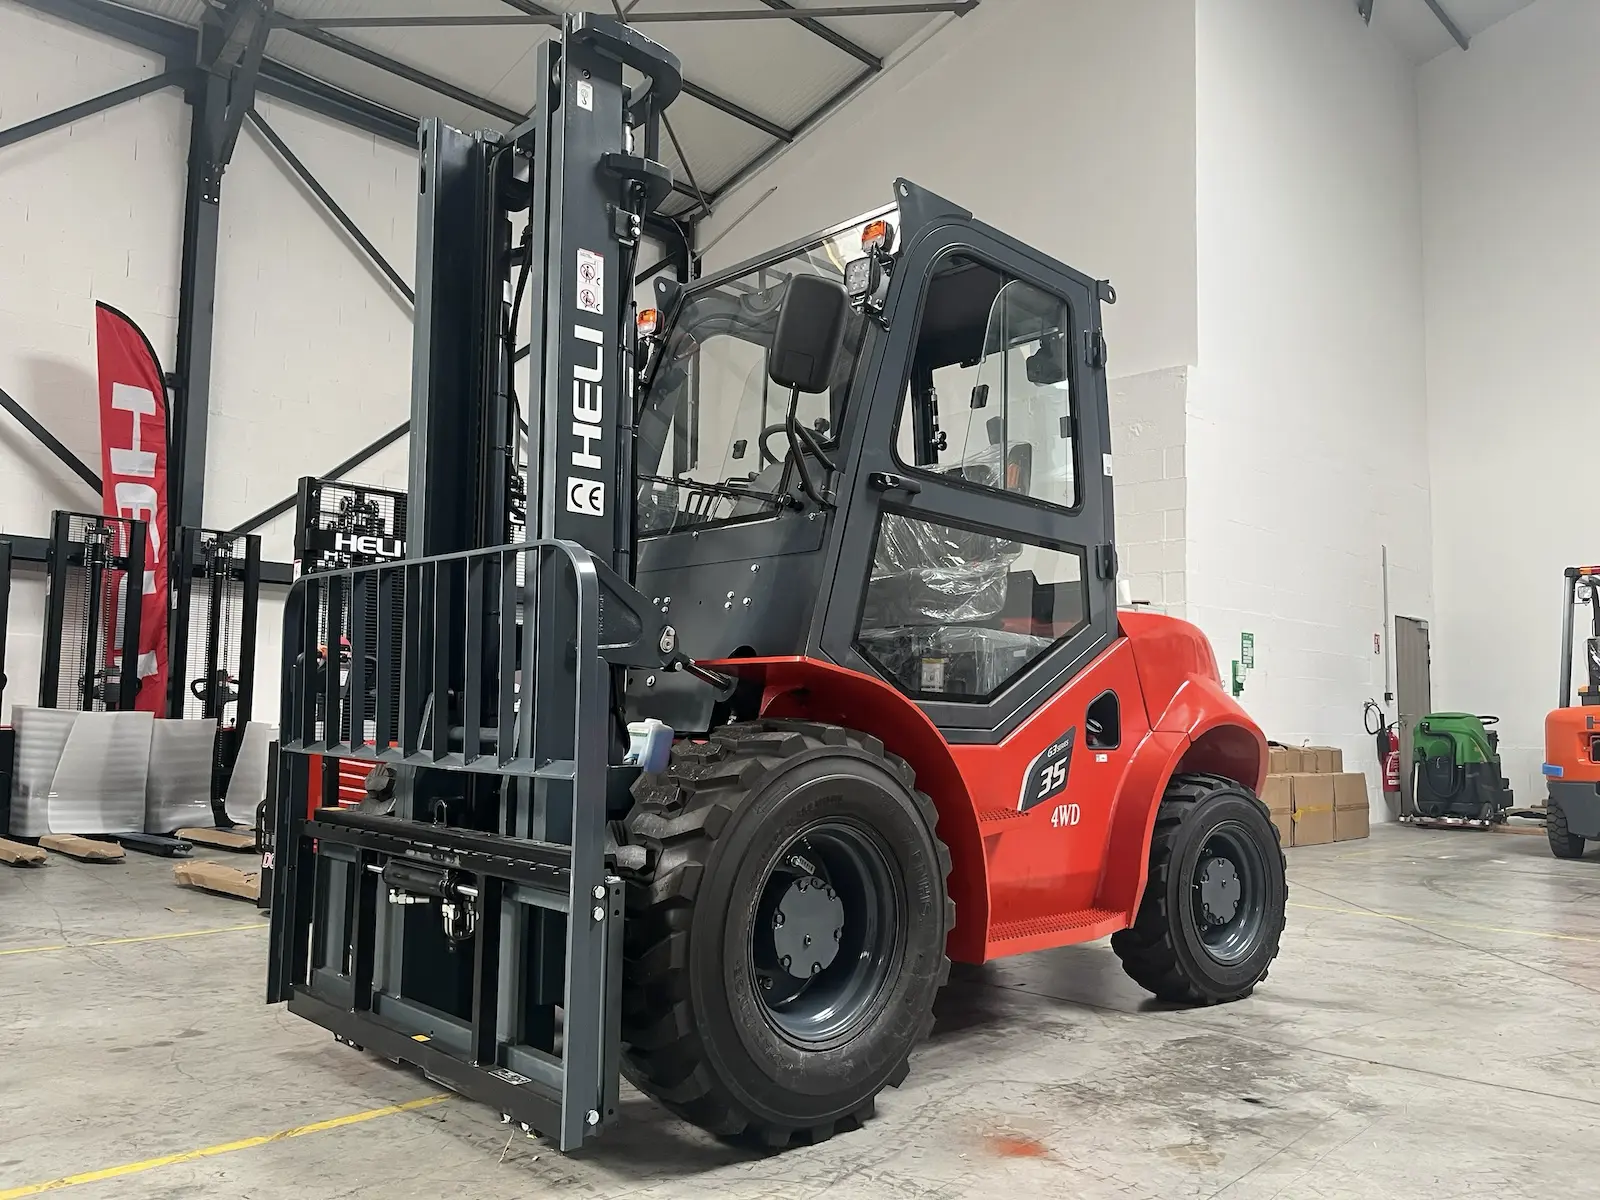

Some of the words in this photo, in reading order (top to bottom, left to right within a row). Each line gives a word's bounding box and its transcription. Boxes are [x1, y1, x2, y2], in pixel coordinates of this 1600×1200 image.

[572, 324, 603, 469] HELI
[571, 483, 601, 511] CE
[335, 533, 401, 557] HELI
[1037, 757, 1067, 798] 35
[1051, 803, 1080, 828] 4WD
